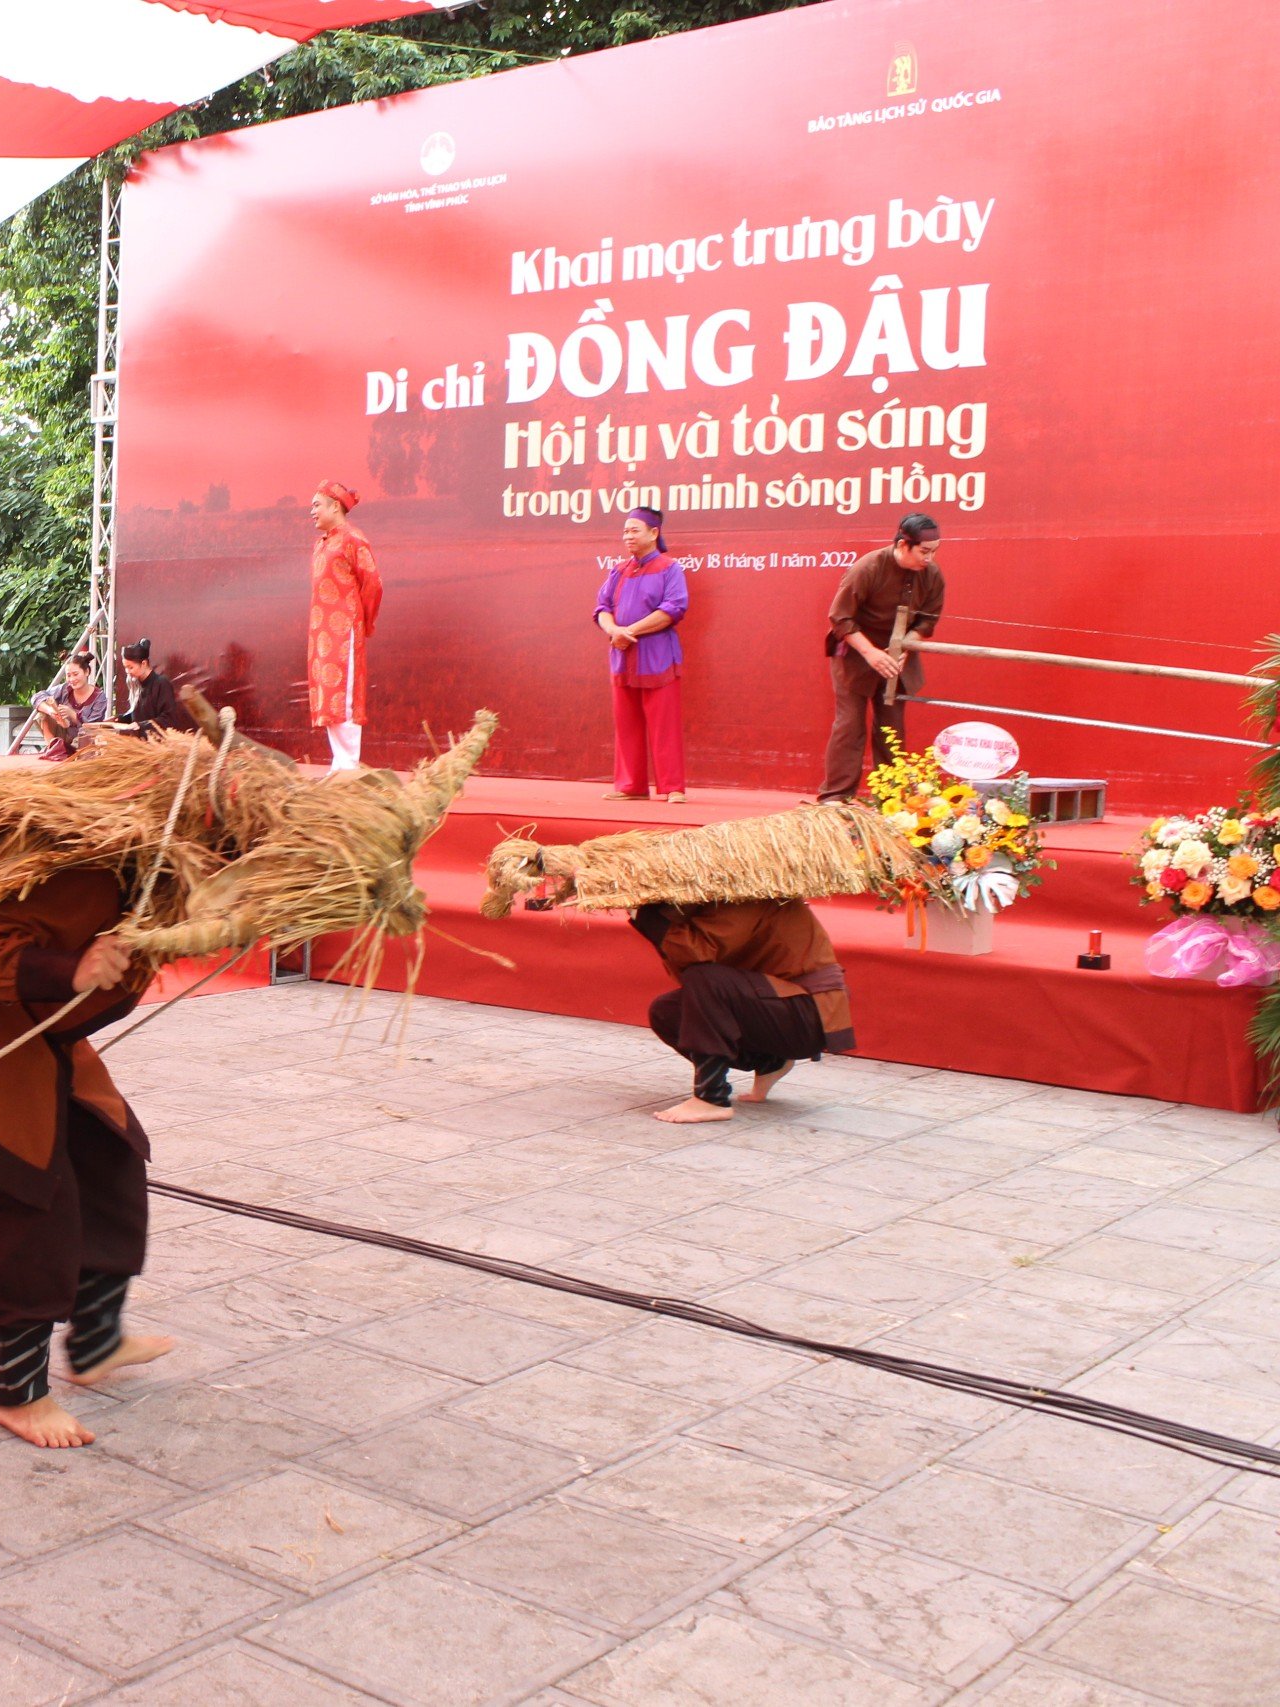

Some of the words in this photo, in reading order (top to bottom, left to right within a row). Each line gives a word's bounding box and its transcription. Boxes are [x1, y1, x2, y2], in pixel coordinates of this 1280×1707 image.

[807, 115, 835, 134] BẢO
[837, 110, 872, 128] TÀNG
[874, 105, 904, 123] LỊCH
[907, 98, 927, 117] SỬ
[931, 91, 974, 112] QUỐC
[975, 88, 1001, 105] GIA
[437, 183, 460, 196] THAO
[473, 177, 486, 188] DU
[510, 236, 614, 296] Khai
[622, 233, 724, 284] mạc
[731, 213, 877, 268] trưng
[887, 195, 996, 252] bày
[366, 368, 408, 416] Di
[422, 361, 485, 411] chỉ
[505, 298, 756, 404] ĐỒNG
[783, 274, 990, 394] ĐẬU
[505, 416, 586, 475] Hội
[596, 414, 648, 471] tụ
[658, 411, 719, 460] và
[731, 393, 824, 457] tỏa
[836, 397, 987, 460] sáng
[502, 484, 591, 523] trong
[598, 481, 661, 514] văn
[669, 474, 759, 511] minh
[765, 472, 861, 515] sông
[869, 462, 986, 511] Hồng
[707, 553, 721, 569] 18
[724, 552, 765, 571] tháng
[770, 552, 778, 568] 11
[782, 552, 816, 568] năm
[820, 551, 858, 568] 2022
